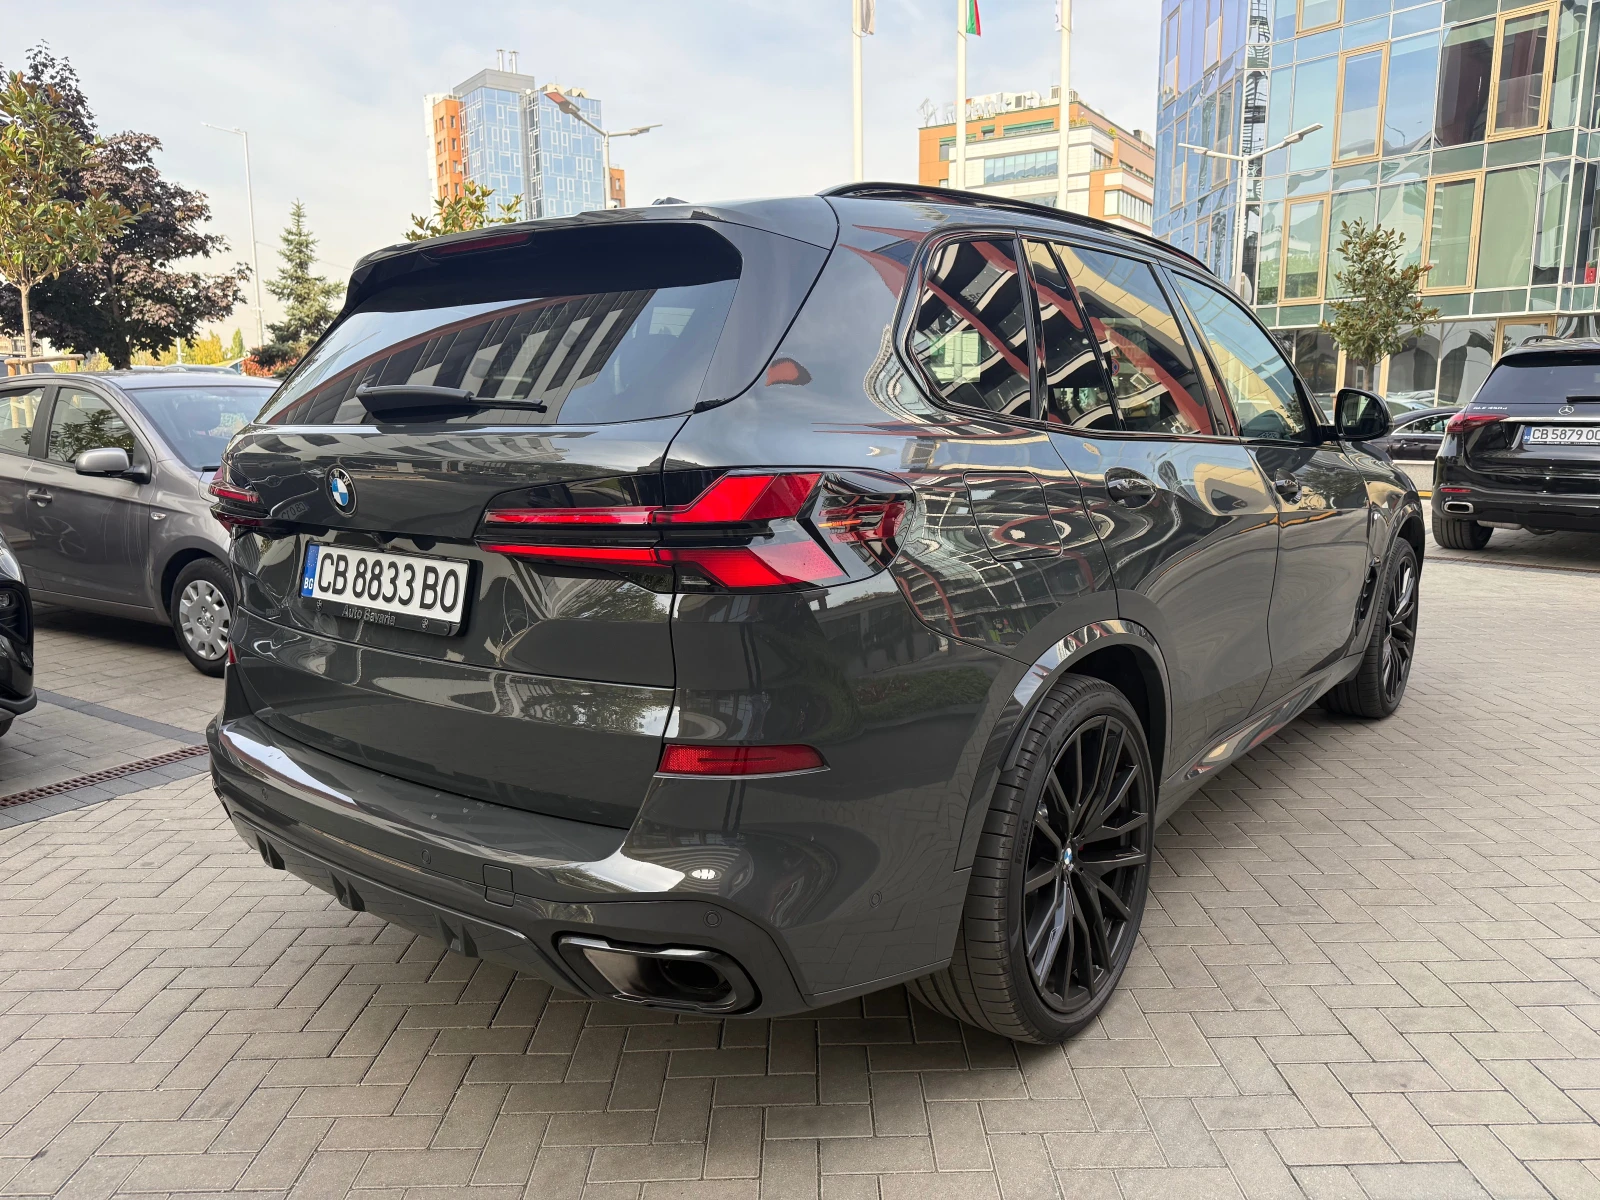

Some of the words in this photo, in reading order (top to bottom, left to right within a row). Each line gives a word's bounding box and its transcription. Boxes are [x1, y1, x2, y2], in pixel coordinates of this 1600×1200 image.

[1532, 428, 1549, 440] CB
[1551, 429, 1584, 440] 5879
[303, 577, 314, 590] BG
[318, 552, 349, 595] CB
[352, 557, 416, 606] 8833
[419, 565, 459, 613] BO
[341, 604, 362, 619] Auto
[363, 607, 396, 626] Bavaria
